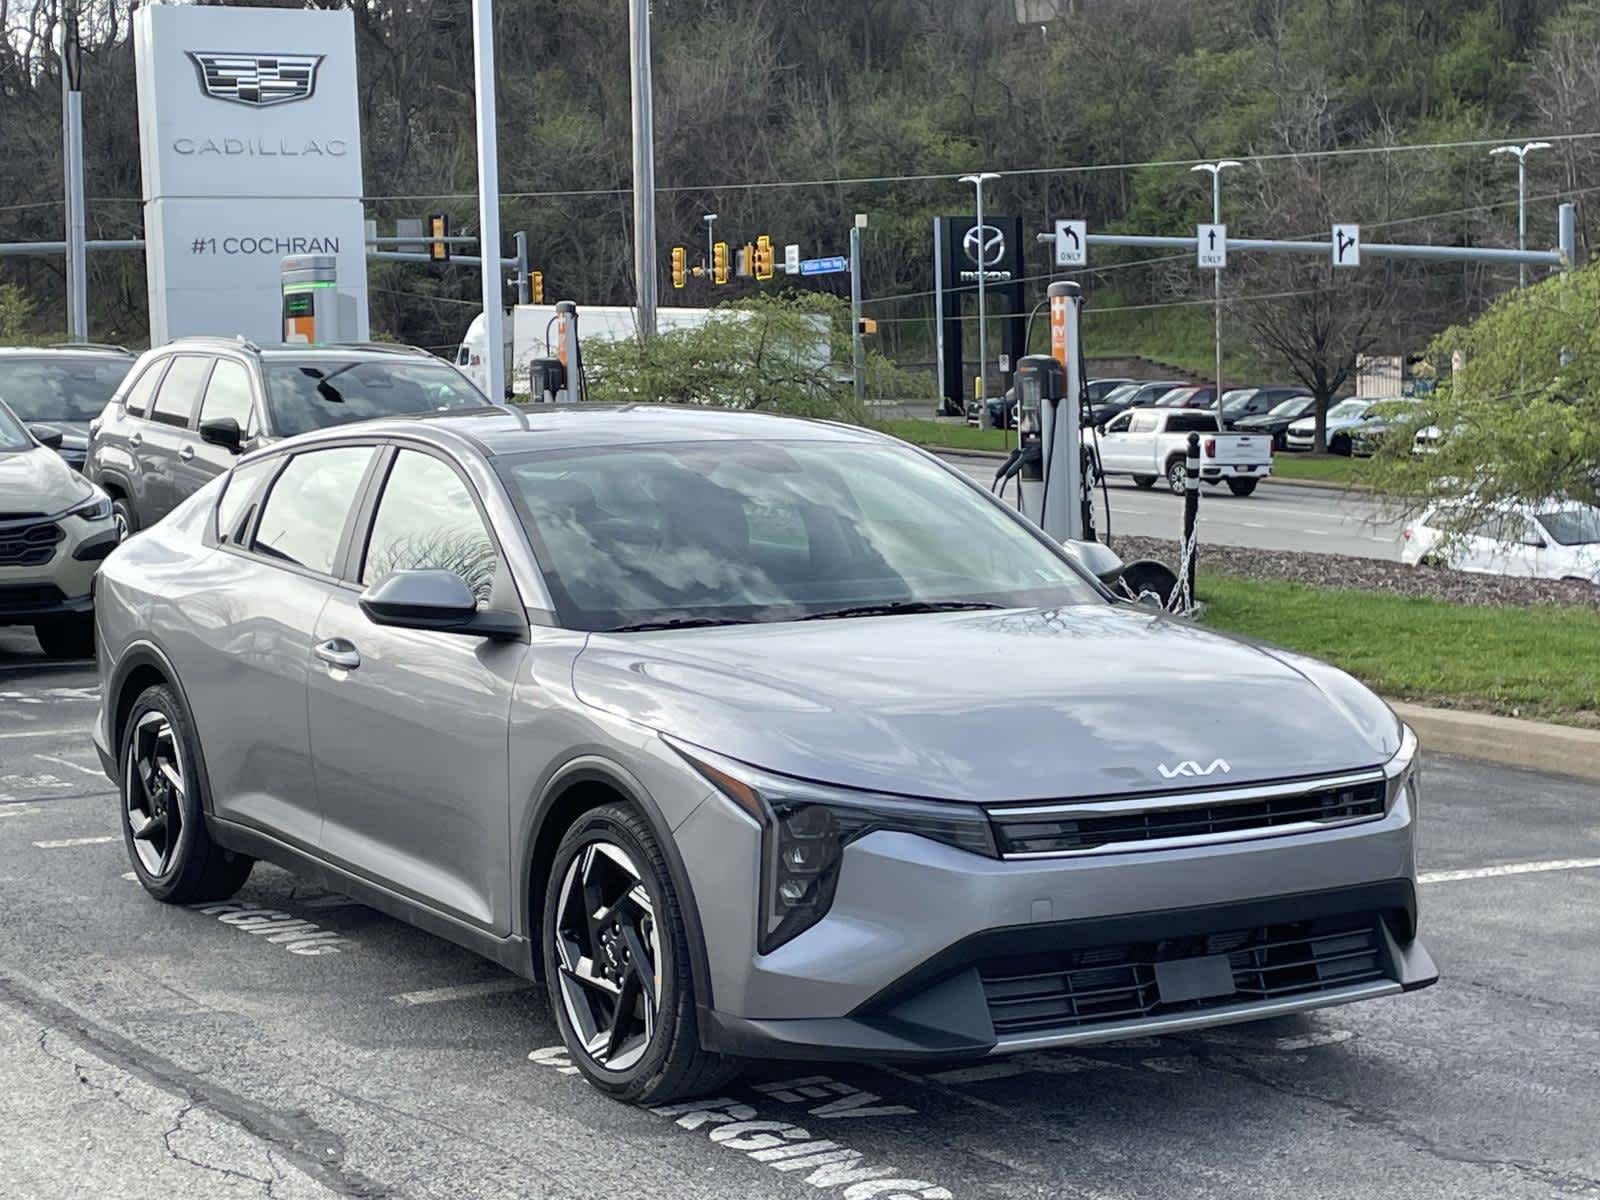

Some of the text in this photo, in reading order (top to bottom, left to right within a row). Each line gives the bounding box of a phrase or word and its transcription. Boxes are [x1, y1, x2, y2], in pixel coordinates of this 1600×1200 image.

[173, 136, 348, 158] CADILLAC
[191, 237, 340, 255] #1 COCHRAN
[1060, 252, 1081, 261] ONLY
[1201, 255, 1222, 264] ONLY
[1157, 757, 1232, 779] KIA
